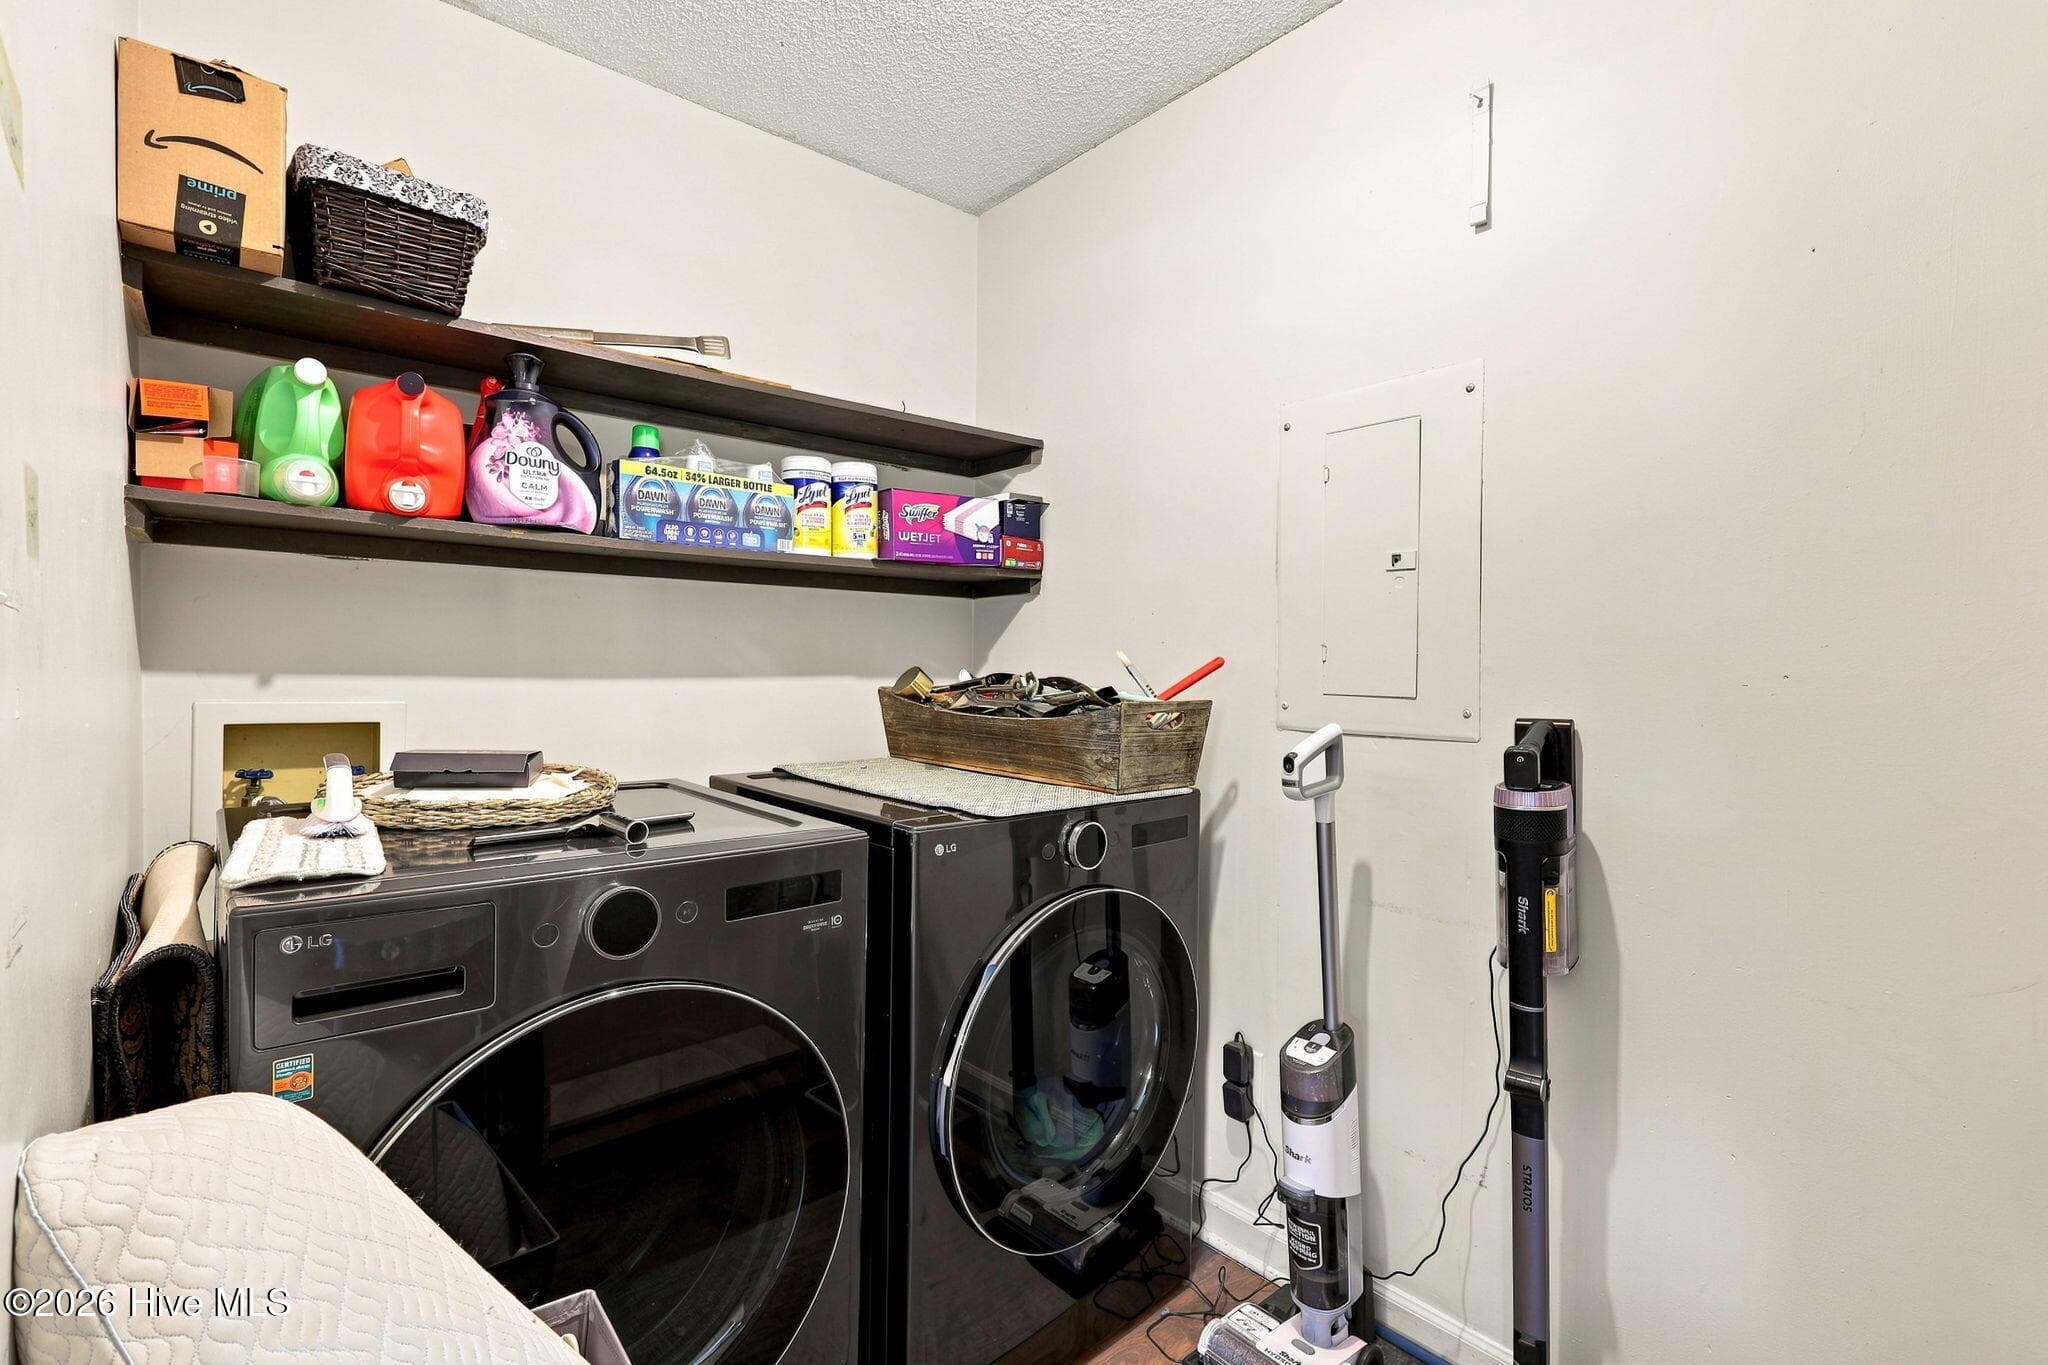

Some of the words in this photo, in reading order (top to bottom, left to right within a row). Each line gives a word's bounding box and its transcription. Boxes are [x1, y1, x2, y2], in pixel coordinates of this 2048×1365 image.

[187, 178, 237, 200] prime
[506, 451, 560, 476] Downy
[522, 482, 548, 491] CALM
[645, 465, 678, 479] 64.5oz
[685, 472, 706, 483] 34%
[708, 475, 740, 489] LARGER
[743, 481, 773, 493] BOTTLE
[638, 490, 668, 502] DAWN
[798, 485, 827, 504] Lysol
[846, 487, 871, 504] Lysol
[700, 498, 726, 510] DAWN
[755, 506, 780, 516] DAWN
[900, 505, 938, 520] Swiffer
[898, 531, 942, 543] WETJET
[946, 843, 956, 853] LG
[1518, 896, 1530, 935] Shark
[307, 934, 333, 949] LG
[276, 1057, 311, 1070] CERTIFIED
[1284, 1145, 1312, 1164] Shark
[1522, 1164, 1532, 1212] STRATOS
